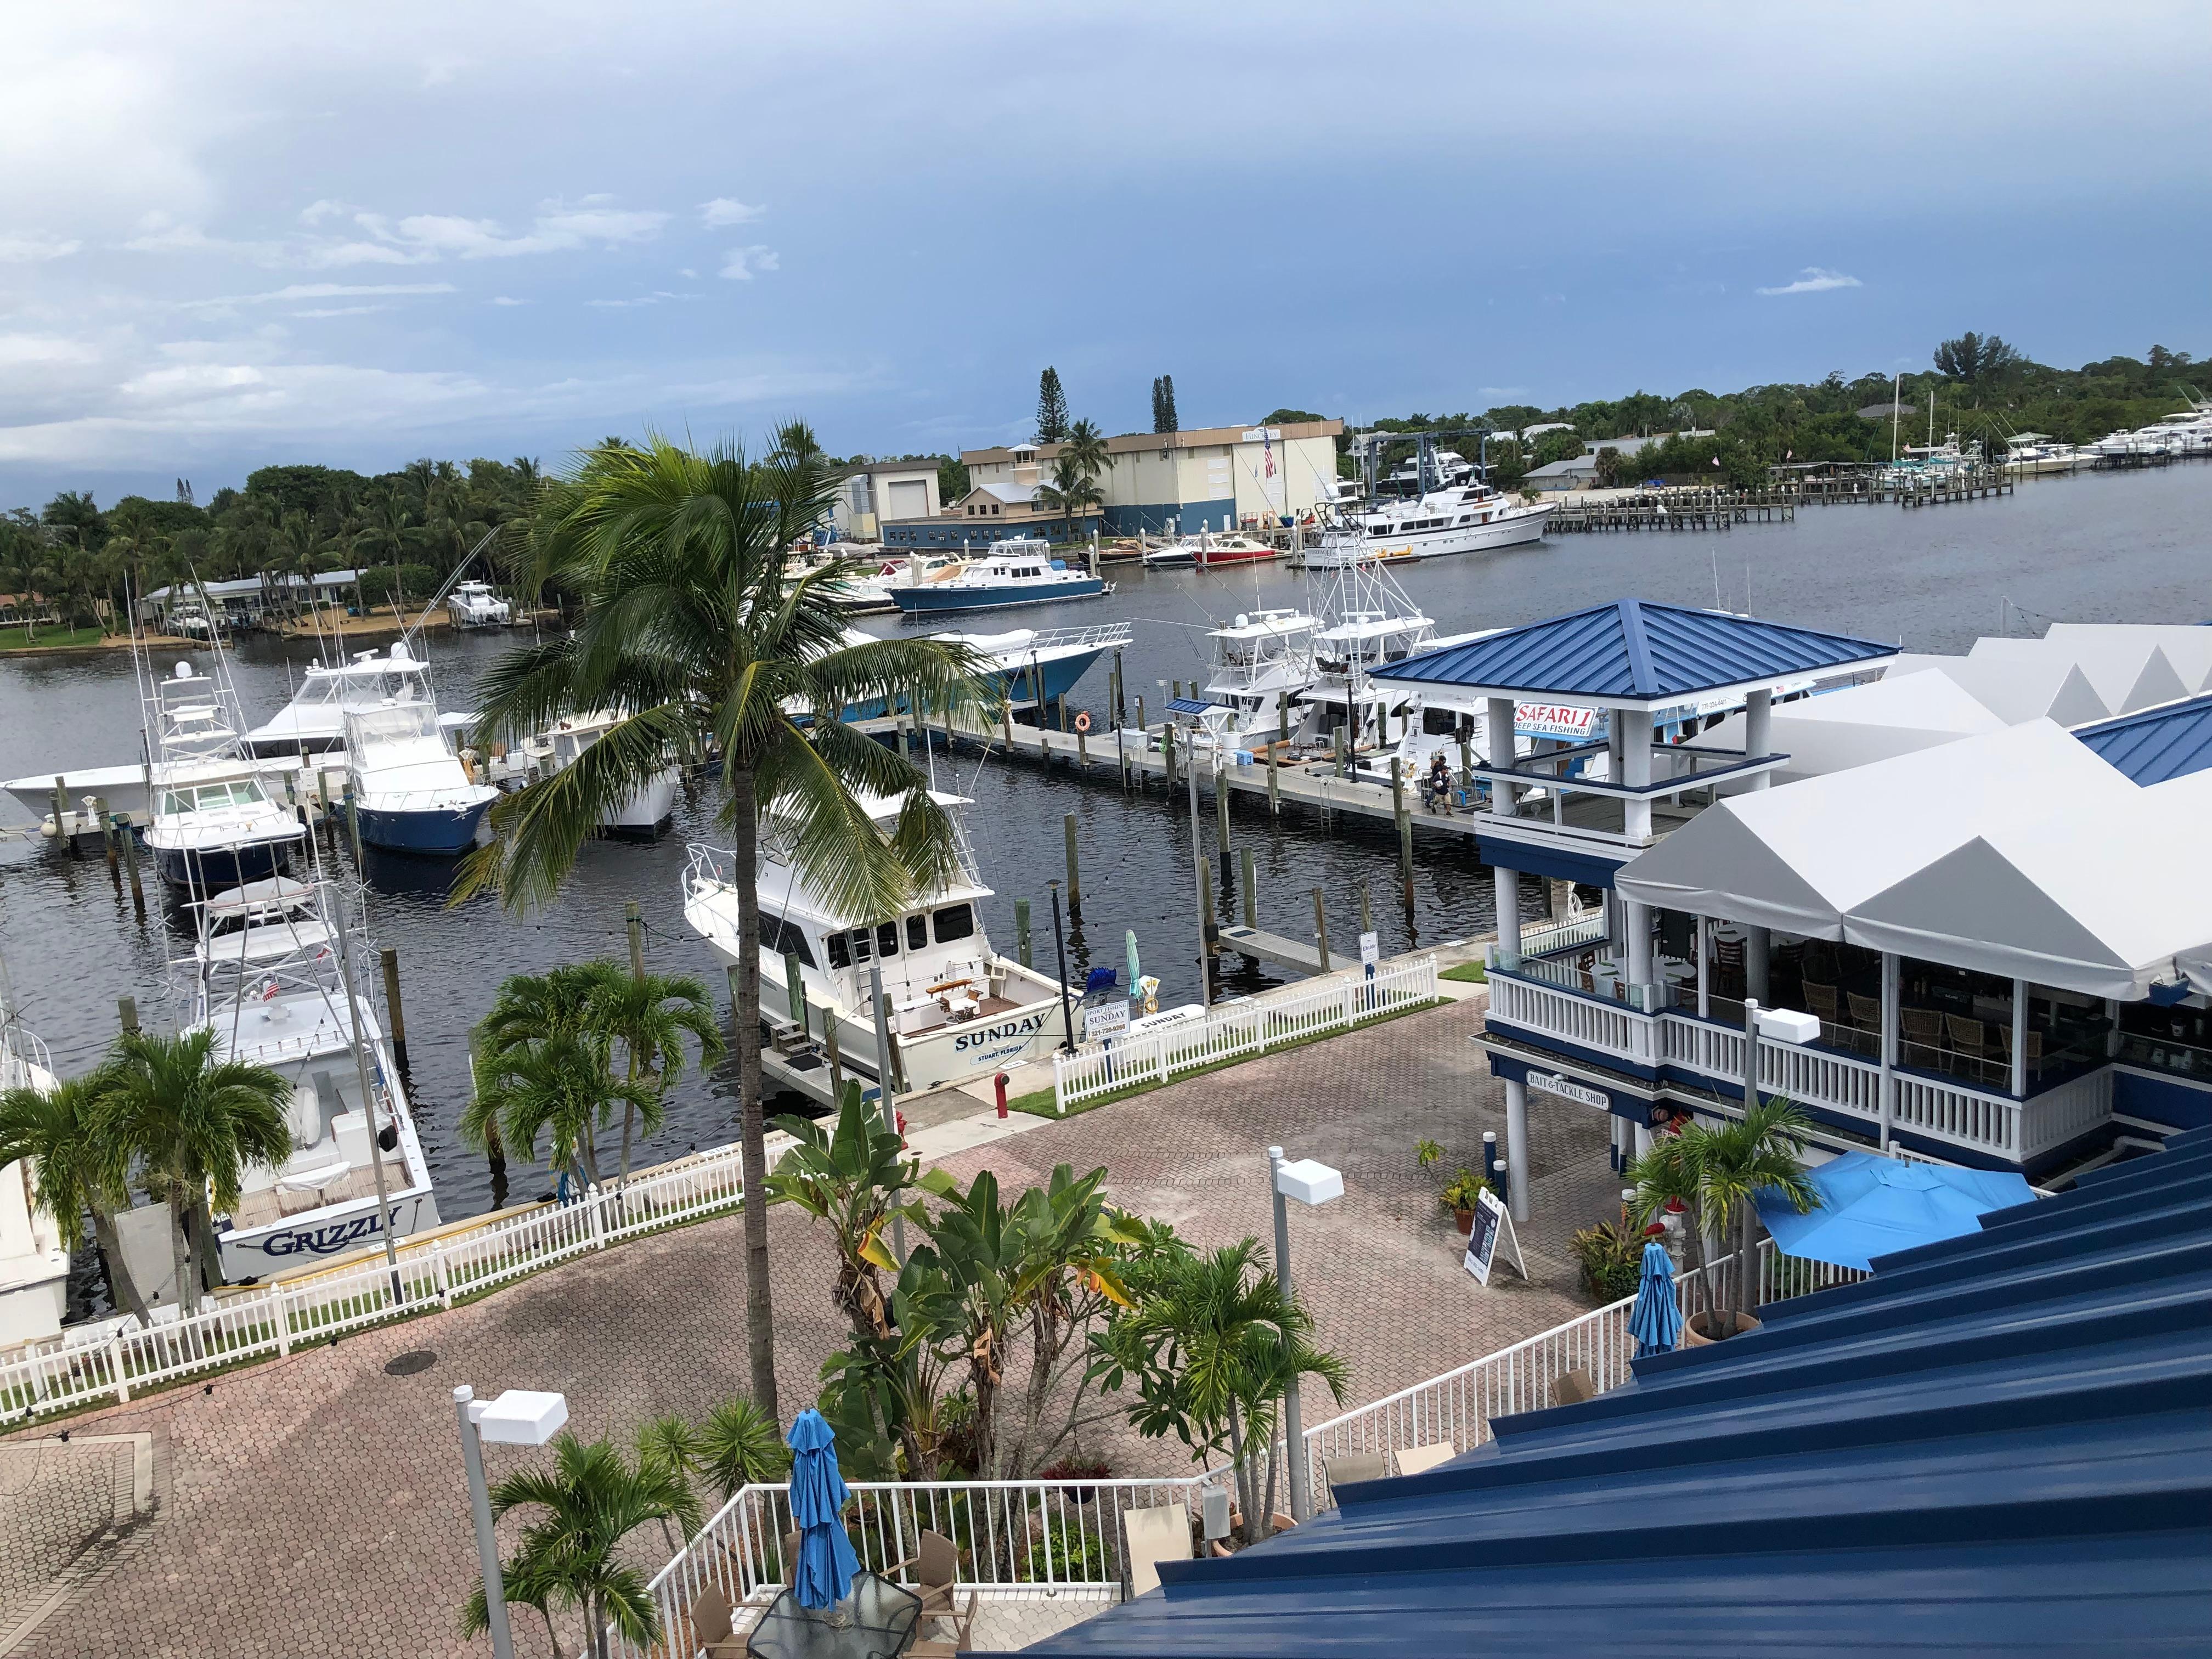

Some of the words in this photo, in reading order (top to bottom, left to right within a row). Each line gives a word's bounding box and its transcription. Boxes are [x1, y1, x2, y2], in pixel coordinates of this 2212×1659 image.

[1245, 432, 1277, 440] HINCKEY
[1516, 705, 1578, 725] SAFARI
[1577, 711, 1591, 727] 1
[1514, 721, 1532, 730] DEEP
[1532, 723, 1547, 731] SEA
[1549, 725, 1586, 735] FISHING
[1104, 1002, 1127, 1012] FISHING
[1090, 1009, 1126, 1025] SUNDAY
[1141, 1012, 1186, 1028] SUNDAY
[955, 1013, 1046, 1052] SUNDAY
[978, 1051, 1000, 1062] STUART,
[1000, 1045, 1023, 1056] FLORIDA
[1528, 1073, 1548, 1087] BAIT
[1548, 1080, 1555, 1088] &
[1554, 1081, 1583, 1099] TACKLE
[1585, 1091, 1606, 1106] SHOP
[263, 1205, 402, 1256] GRIZZLY
